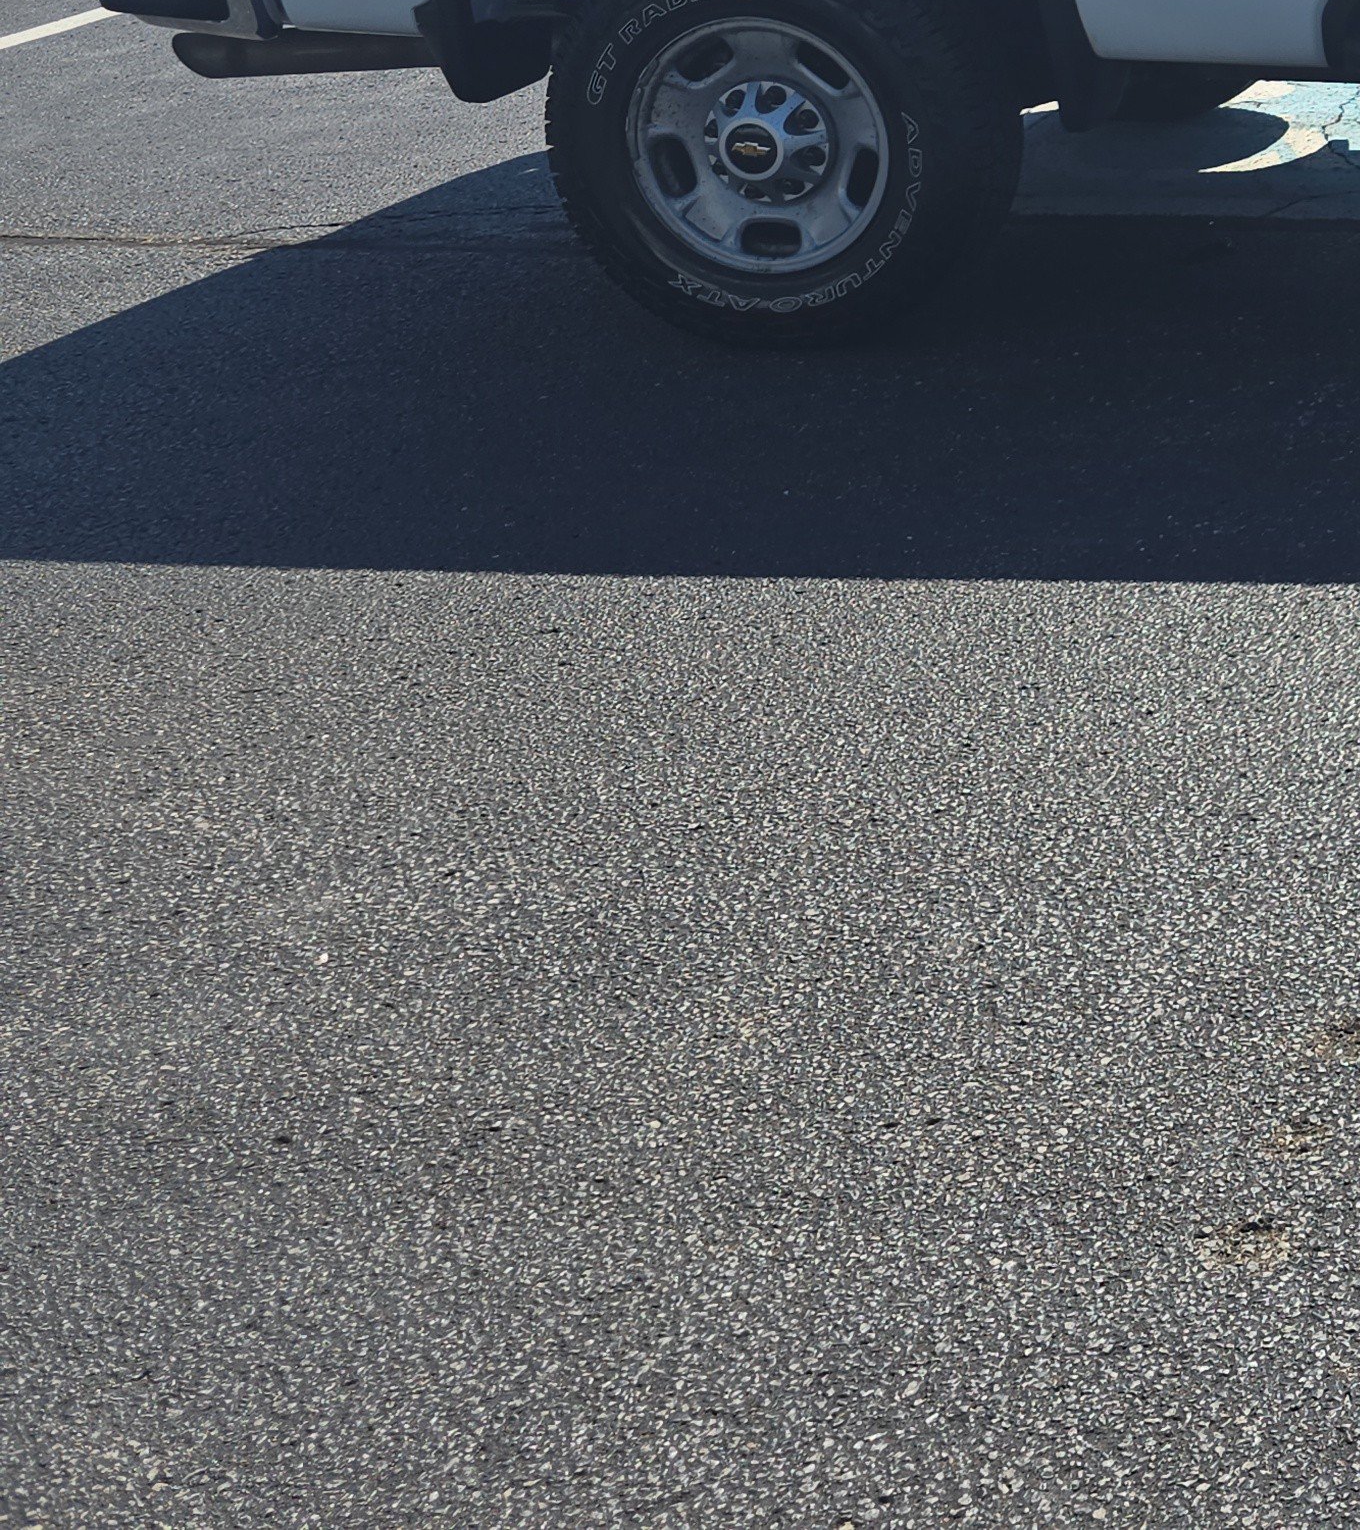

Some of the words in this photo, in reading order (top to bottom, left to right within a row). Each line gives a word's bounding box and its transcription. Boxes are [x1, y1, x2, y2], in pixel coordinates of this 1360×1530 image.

[586, 44, 618, 105] GT
[769, 112, 923, 313] ADVENTURO
[668, 273, 761, 312] ATX
